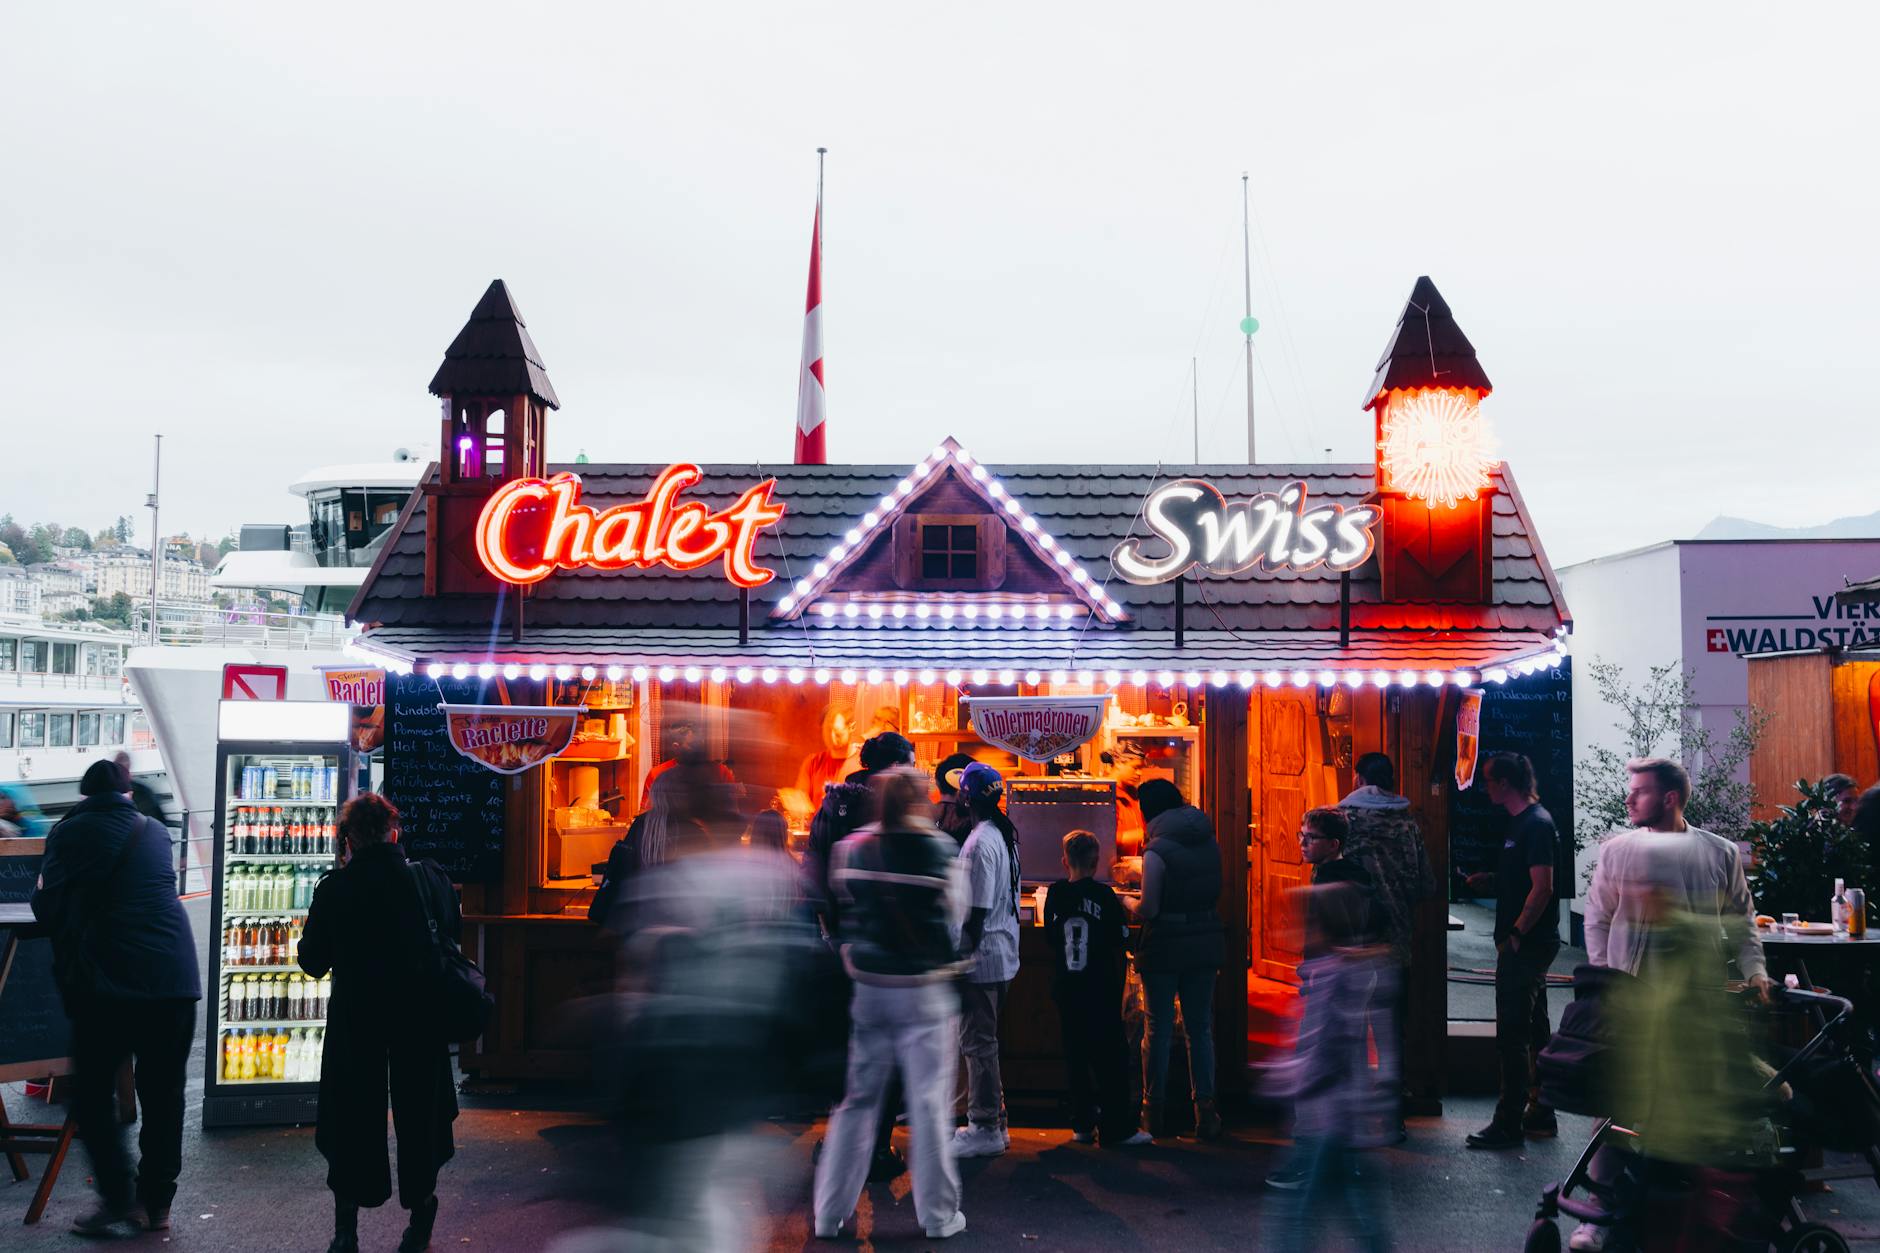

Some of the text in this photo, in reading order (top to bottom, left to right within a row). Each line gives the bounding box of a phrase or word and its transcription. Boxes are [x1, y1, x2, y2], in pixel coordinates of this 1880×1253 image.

[476, 463, 787, 588] Chalet
[1110, 479, 1384, 585] Swiss
[1812, 595, 1880, 619] VIER
[329, 677, 385, 706] Raclett
[460, 717, 548, 749] Raclette
[983, 707, 1090, 739] Älplermagronen
